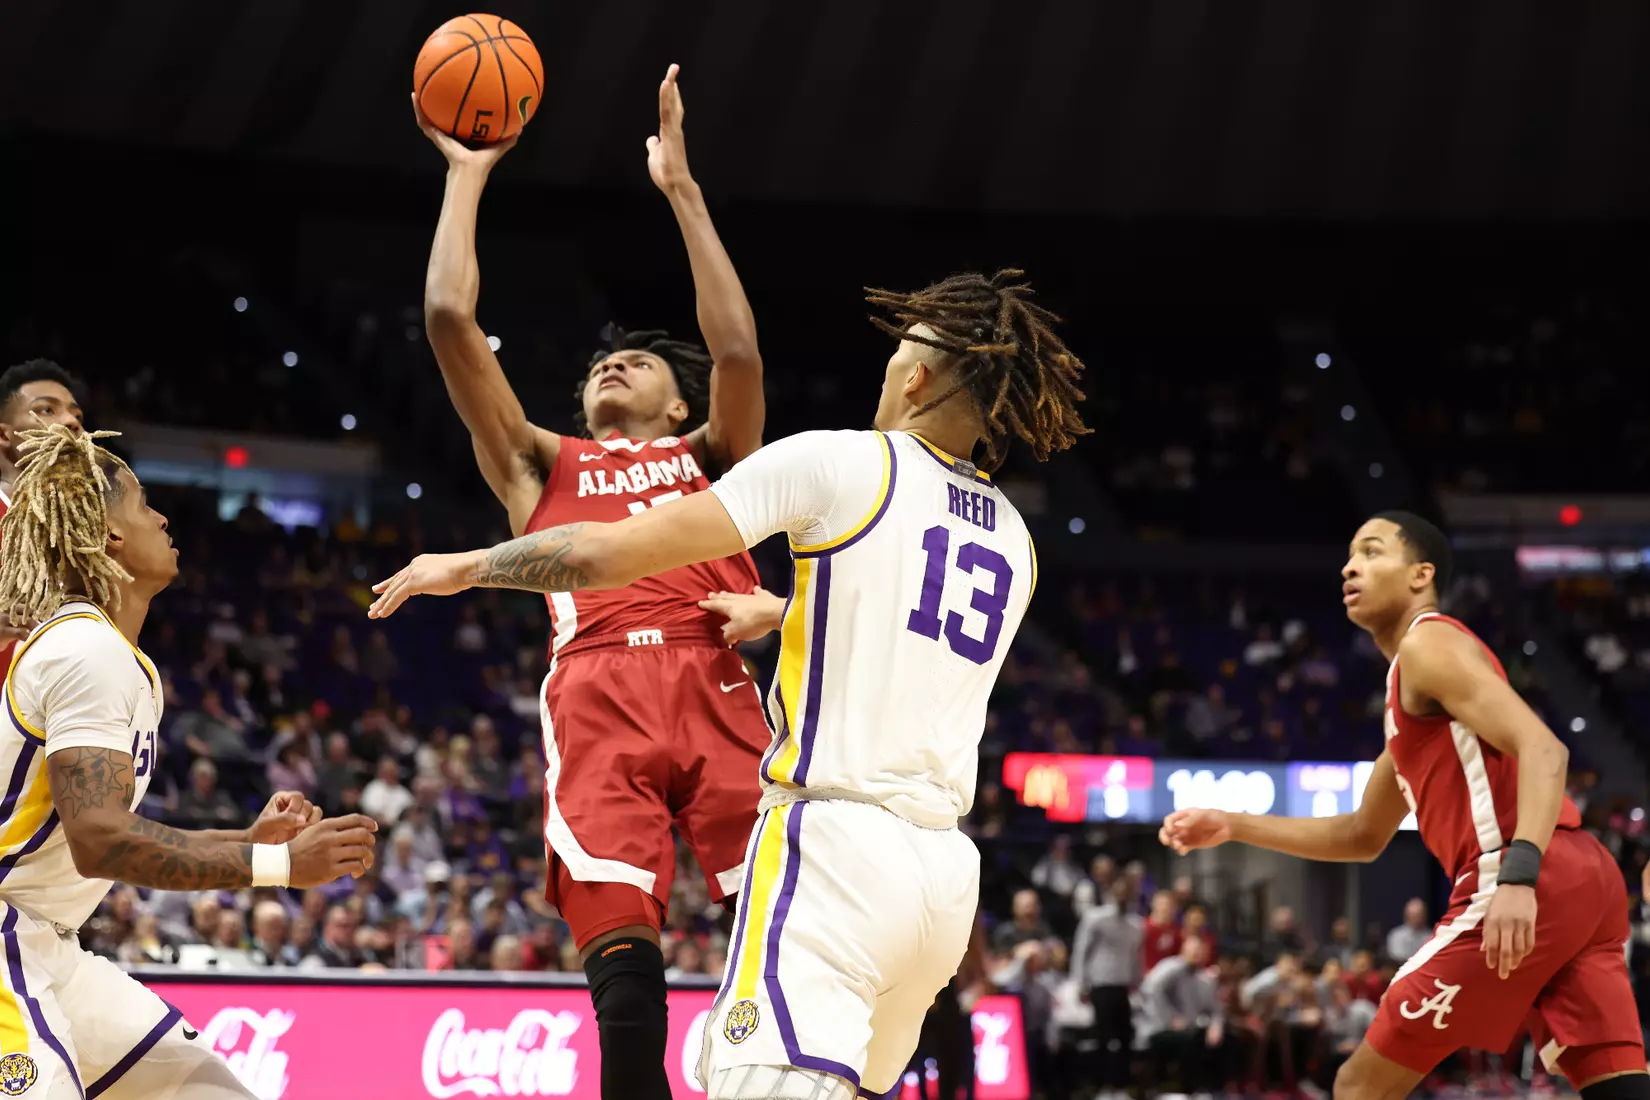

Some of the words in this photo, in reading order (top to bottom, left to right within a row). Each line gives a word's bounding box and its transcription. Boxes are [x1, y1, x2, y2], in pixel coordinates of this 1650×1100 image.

[577, 453, 703, 498] ALABAMA
[946, 481, 996, 532] REED
[906, 524, 1014, 666] 13
[626, 629, 664, 647] RTR
